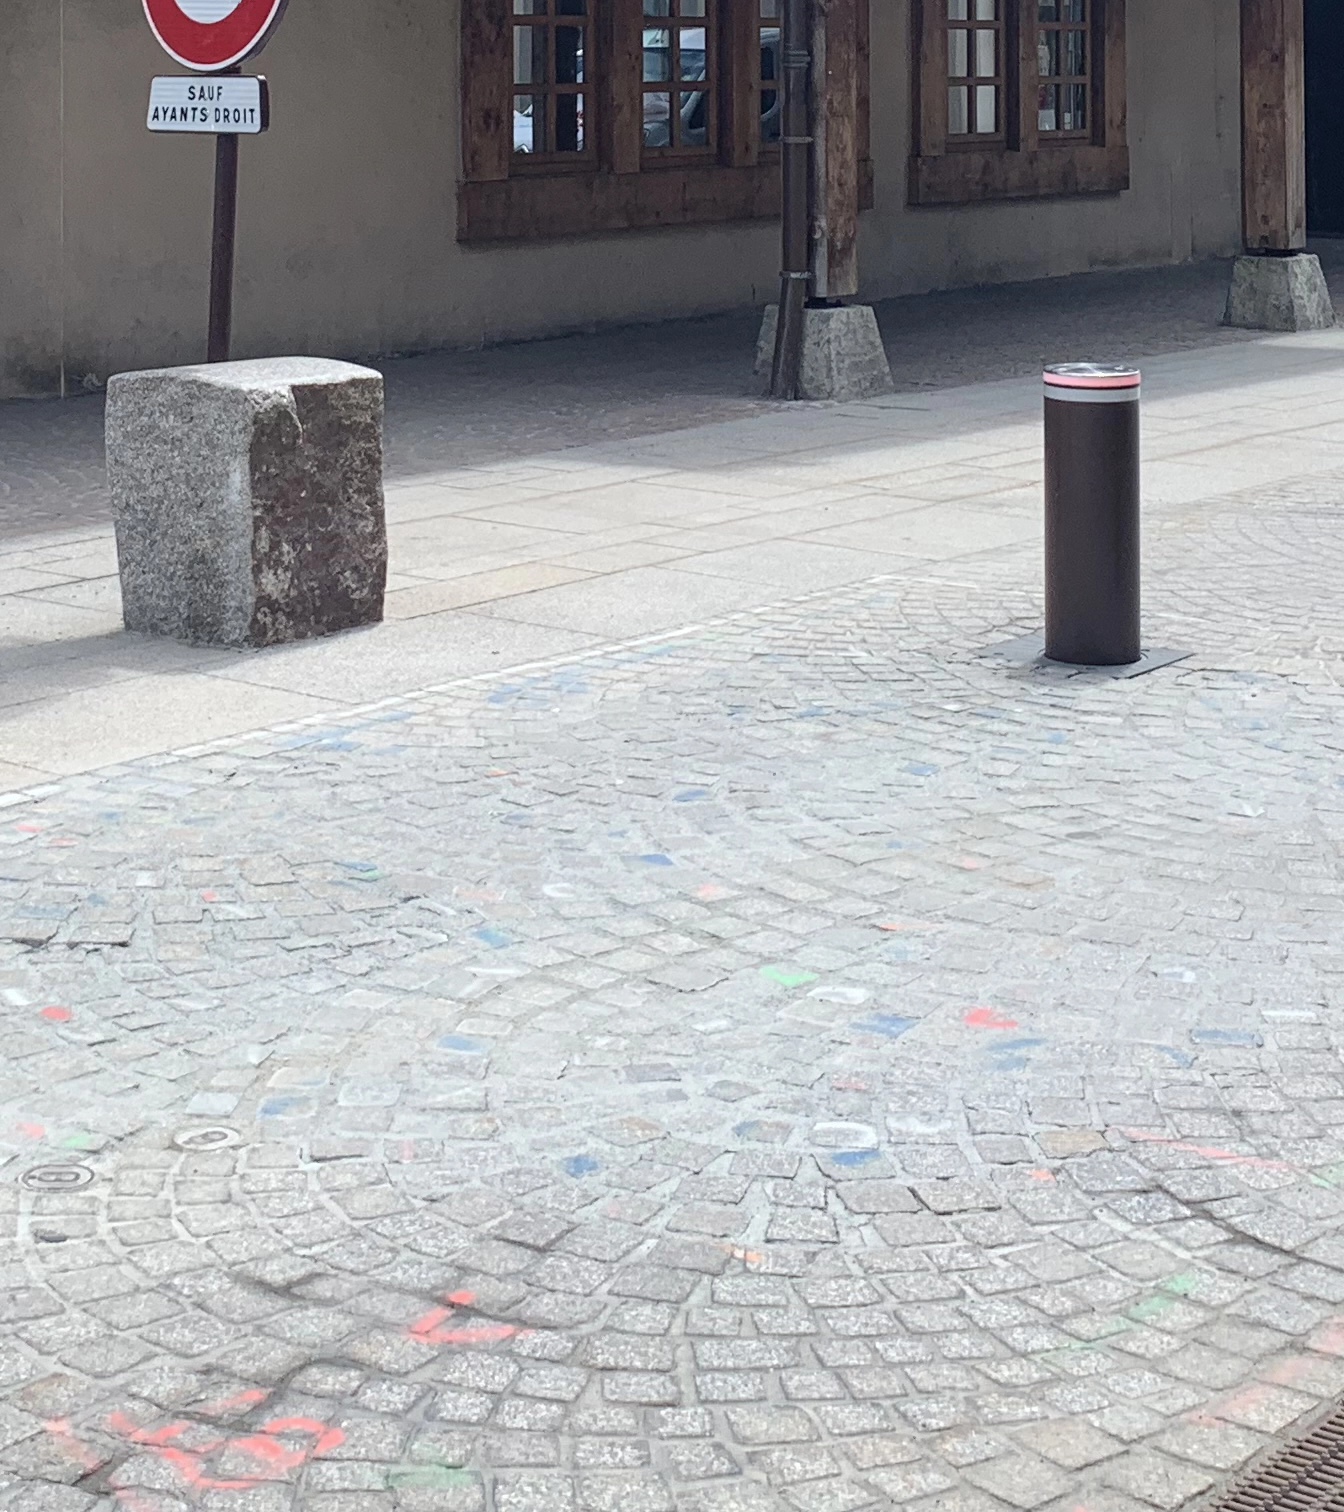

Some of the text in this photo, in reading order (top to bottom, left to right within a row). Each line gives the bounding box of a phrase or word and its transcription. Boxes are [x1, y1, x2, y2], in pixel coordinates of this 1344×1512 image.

[187, 85, 224, 101] SAUF
[151, 105, 256, 124] AYANTS DROIT
